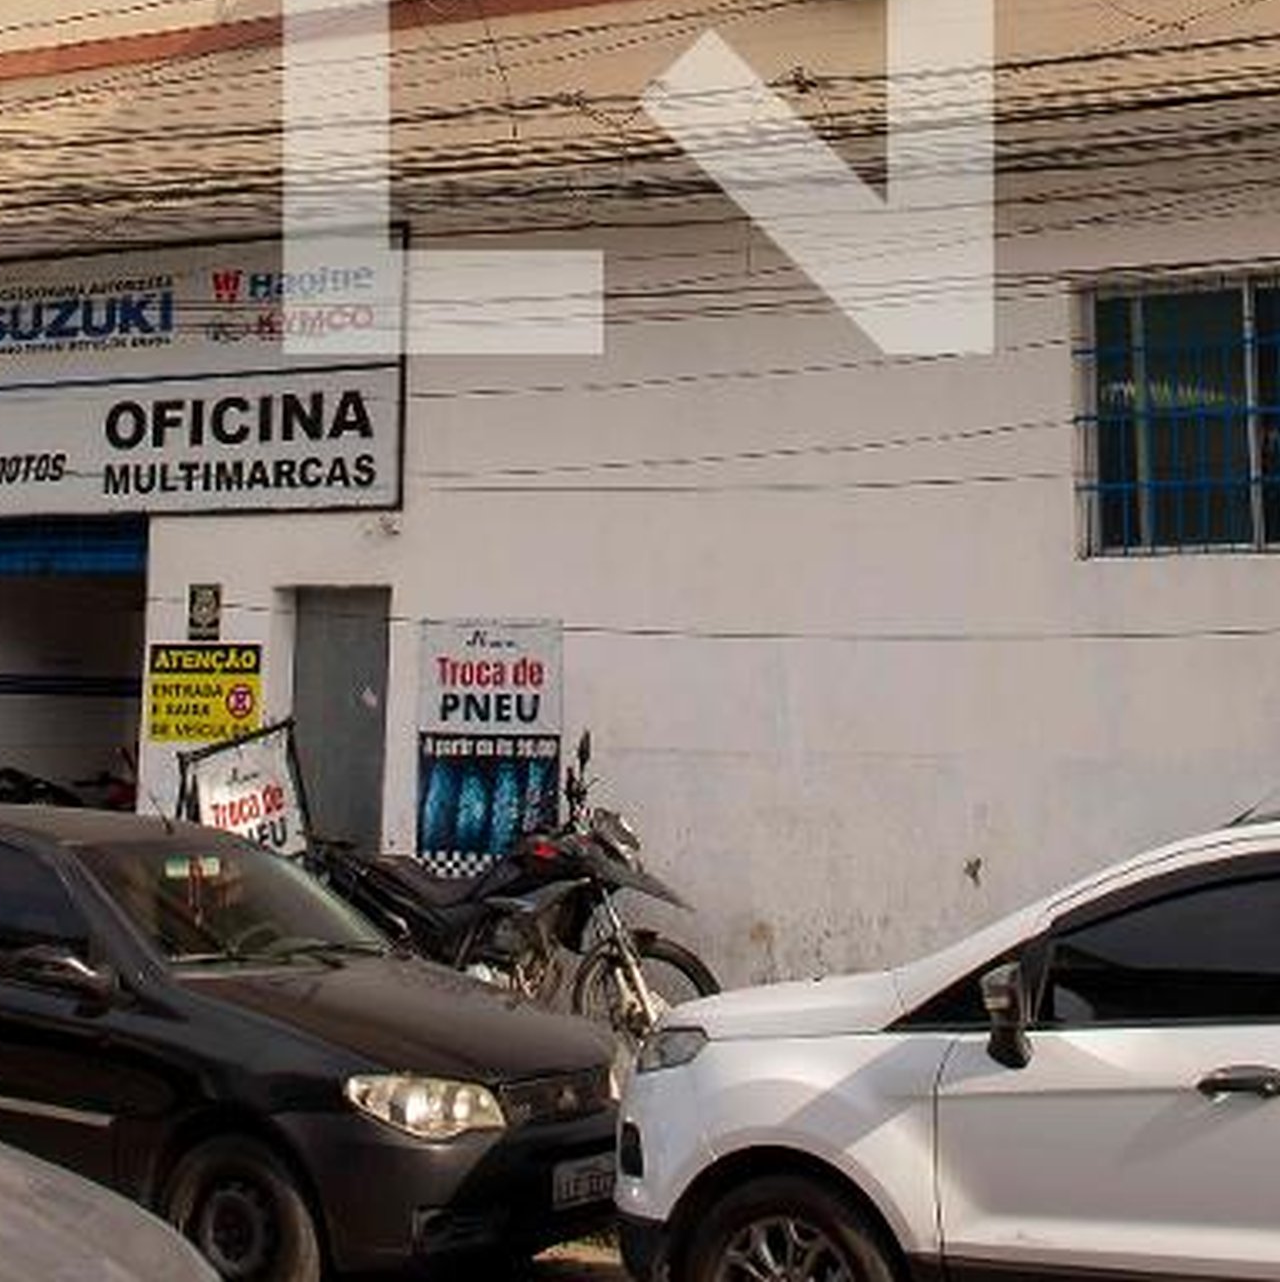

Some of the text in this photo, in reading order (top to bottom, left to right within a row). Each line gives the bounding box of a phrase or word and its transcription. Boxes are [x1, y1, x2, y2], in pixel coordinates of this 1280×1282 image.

[105, 390, 374, 450] OFICINA
[104, 454, 376, 495] MULTIMARCAS
[155, 648, 257, 673] ATENÇÃO
[437, 658, 543, 687] Troca de
[151, 683, 224, 698] ENTRADA
[441, 693, 540, 722] PNEU
[211, 784, 284, 829] Troca de
